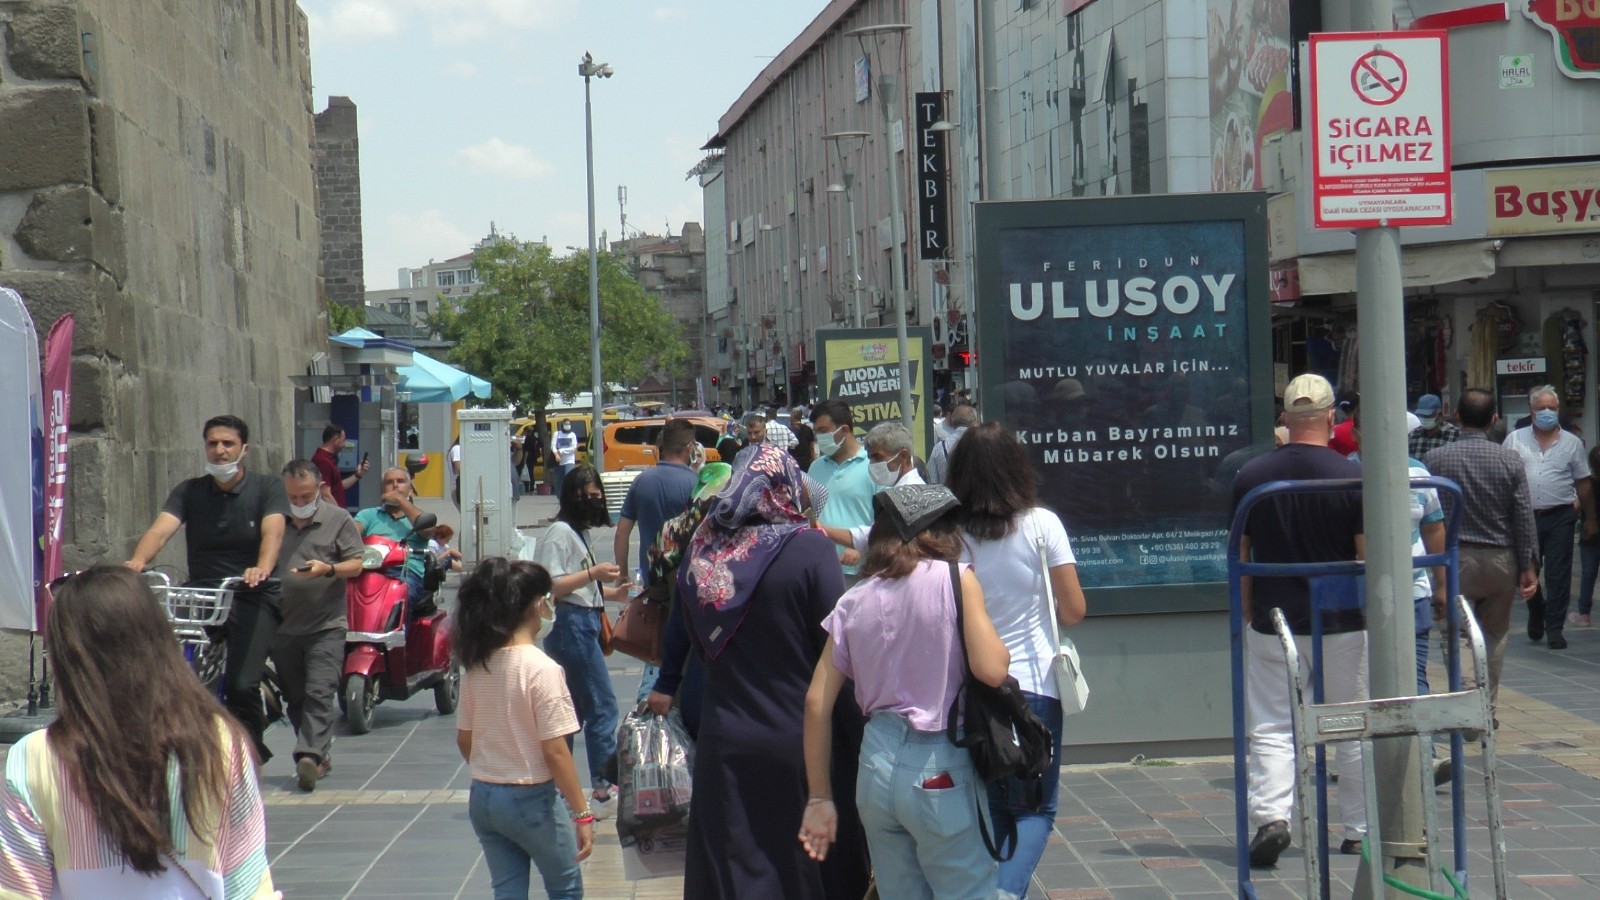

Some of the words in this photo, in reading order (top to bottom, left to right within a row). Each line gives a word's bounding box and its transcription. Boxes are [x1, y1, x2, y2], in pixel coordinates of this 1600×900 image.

[1502, 67, 1531, 77] HALAL
[1328, 115, 1433, 138] SİGARA
[1329, 142, 1434, 169] İÇİLMEZ
[921, 103, 940, 248] TEKBİR
[1043, 256, 1200, 272] FERİDUN
[1009, 274, 1236, 320] ULUSOY
[1107, 324, 1226, 342] İNŞAAT
[844, 366, 887, 382] MODA
[1020, 366, 1077, 379] MUTLU
[1085, 362, 1165, 376] YUVALAR
[1173, 358, 1229, 374] İÇİN...
[1506, 361, 1536, 372] tekir
[839, 378, 900, 397] ALIŞVERİ
[1016, 429, 1097, 444] Kurban
[1108, 424, 1238, 443] Bayramınız
[48, 403, 56, 486] Teleko
[1043, 446, 1142, 463] Mübarek
[1154, 444, 1219, 459] Olsun
[1076, 558, 1124, 567] oyinsaat.com
